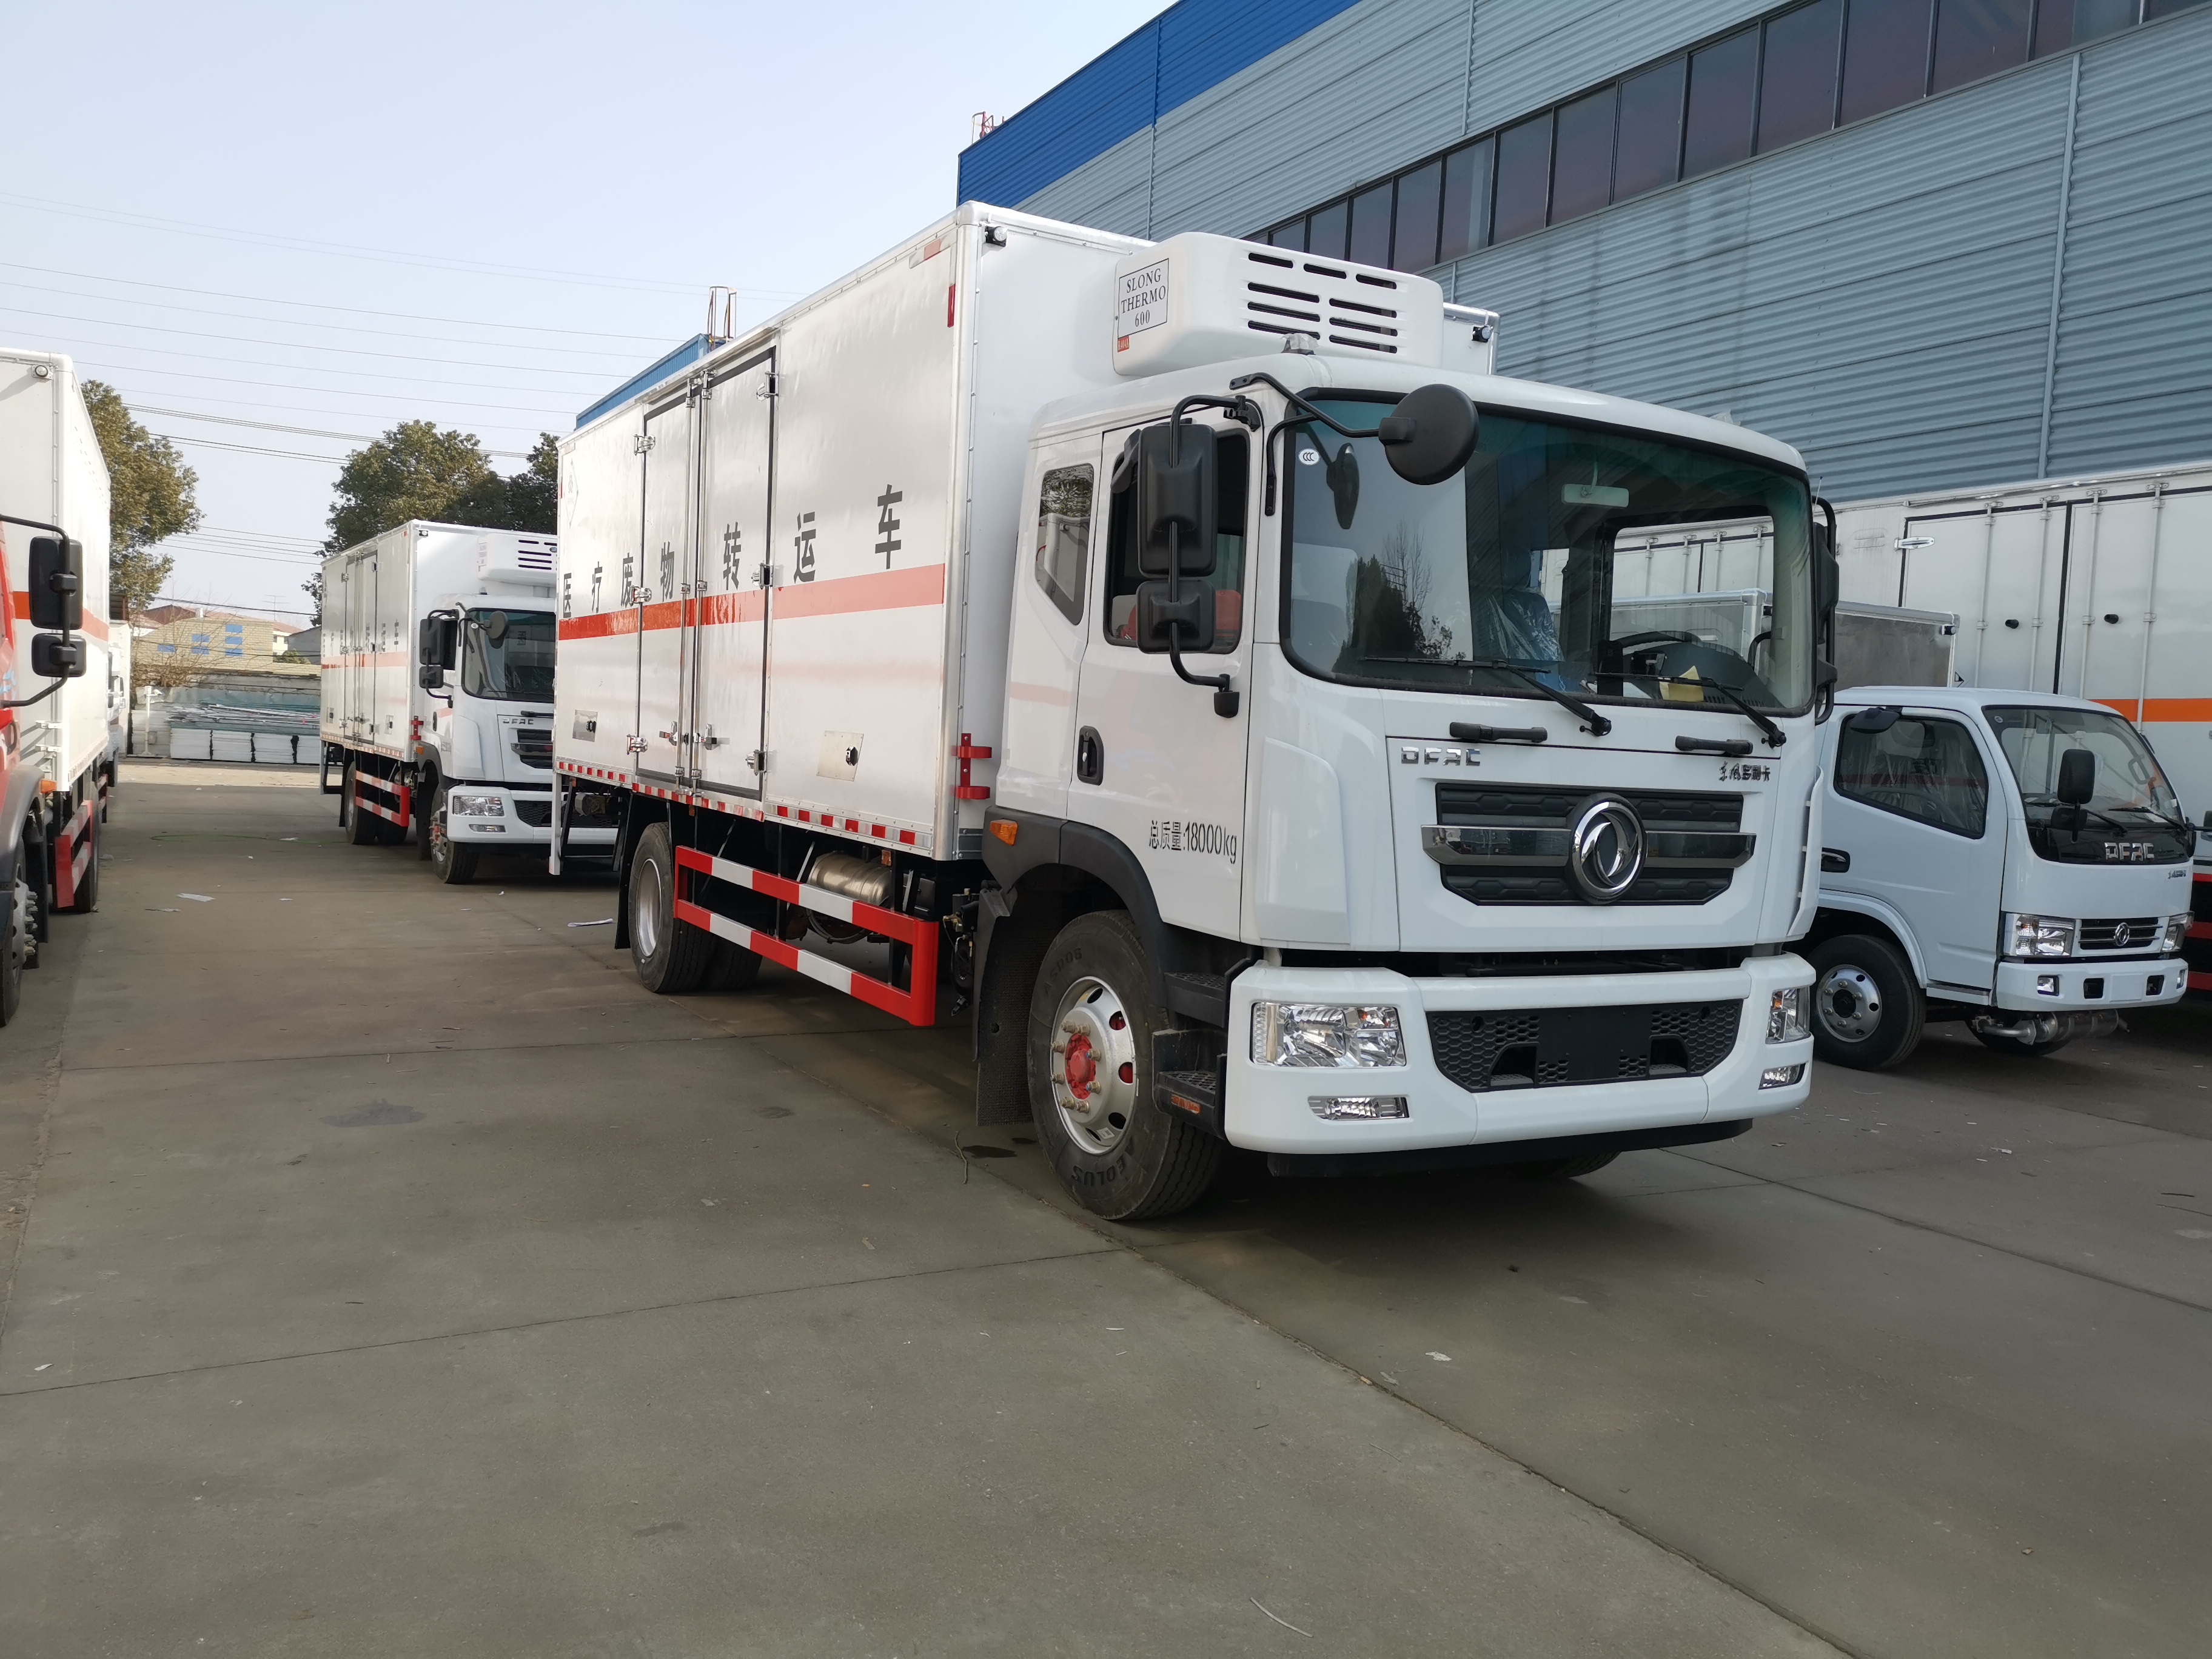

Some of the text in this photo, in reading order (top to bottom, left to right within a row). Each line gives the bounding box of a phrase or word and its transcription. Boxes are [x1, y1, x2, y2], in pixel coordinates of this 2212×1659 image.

[1127, 268, 1161, 293] SLONG
[1121, 286, 1166, 313] THERMO
[1135, 310, 1150, 327] 600
[1401, 746, 1481, 766] DFAC
[2105, 842, 2154, 861] DFAC
[1071, 1136, 1135, 1186] AEOLUS
